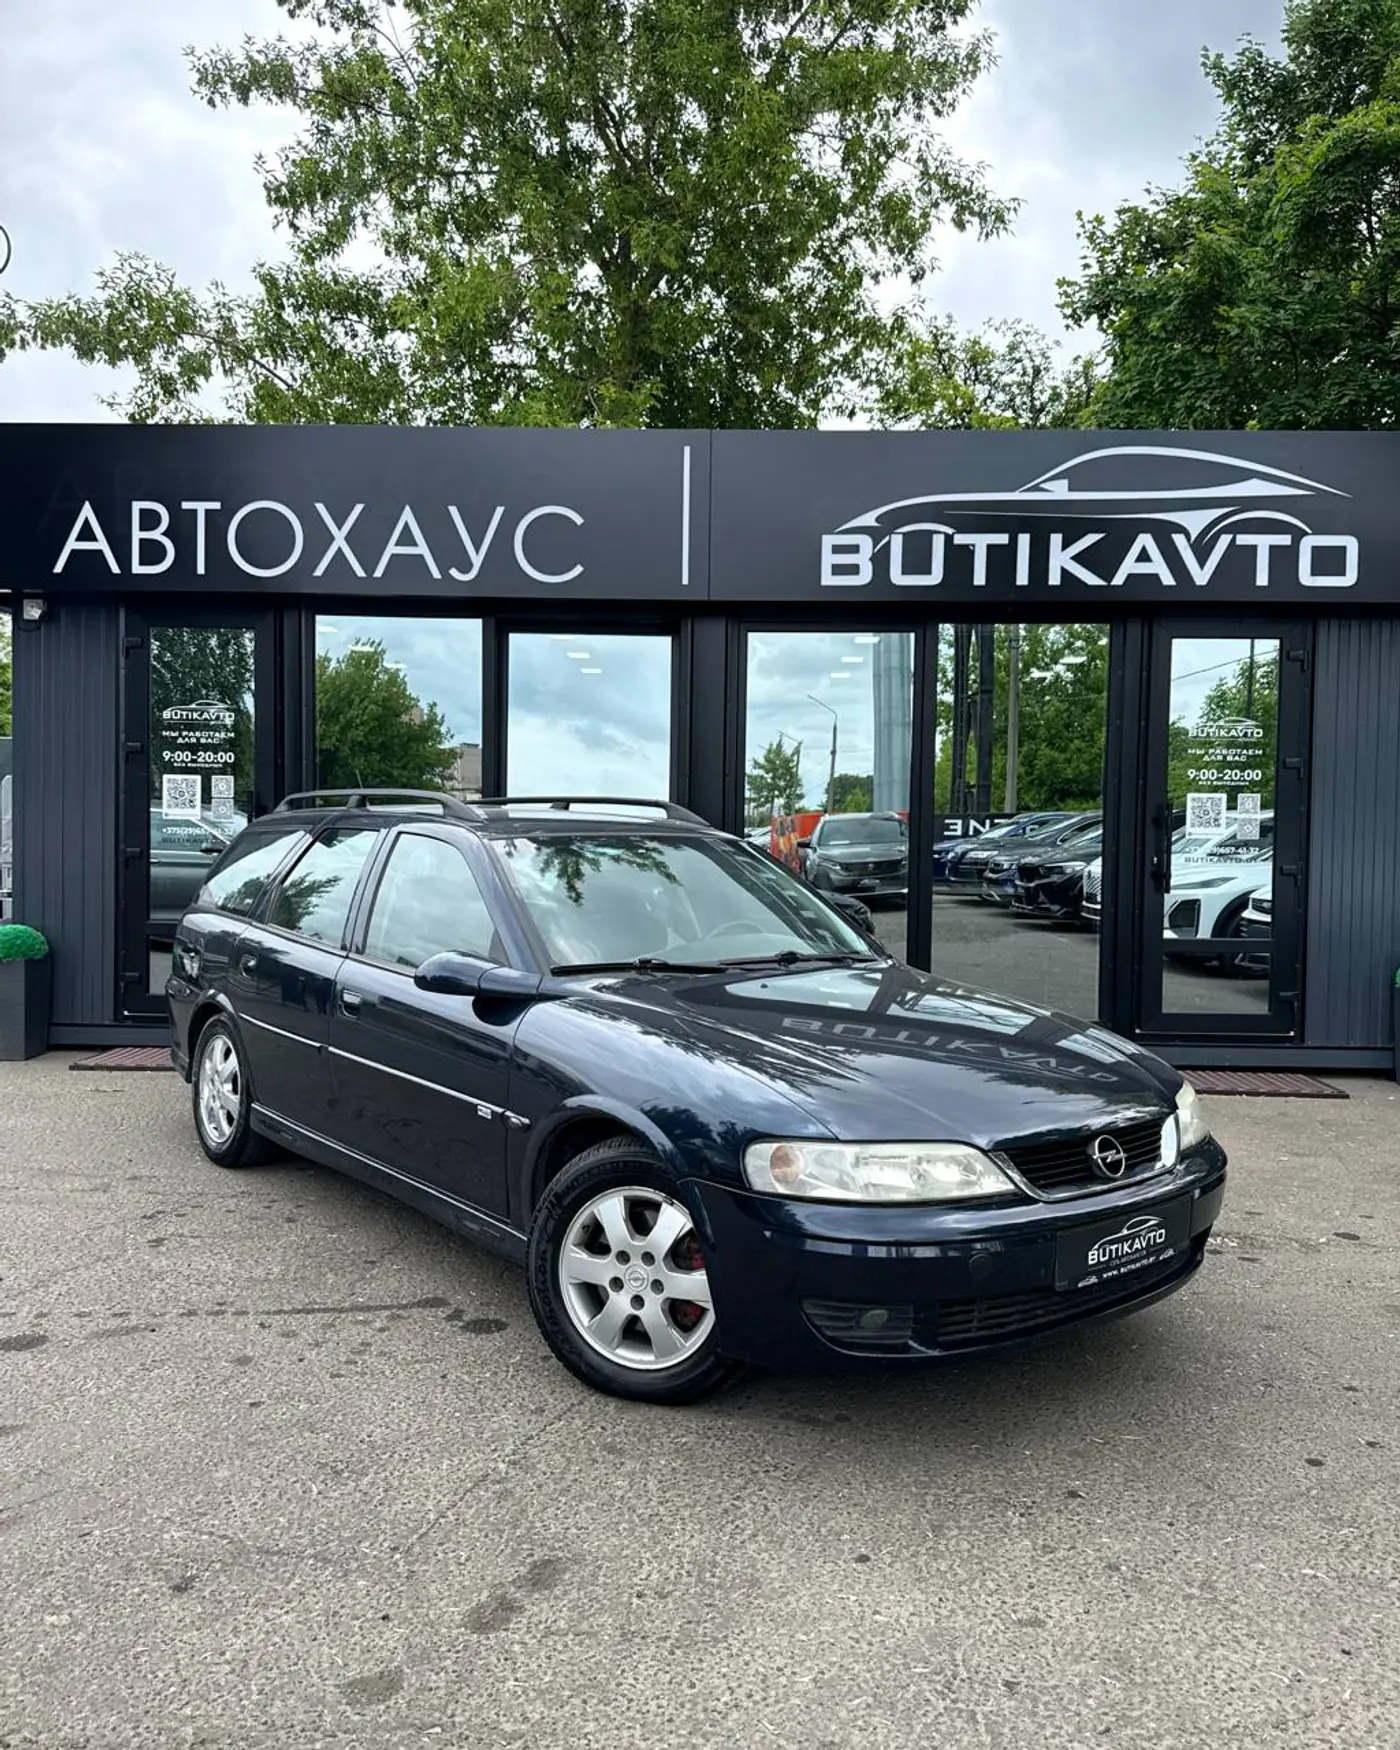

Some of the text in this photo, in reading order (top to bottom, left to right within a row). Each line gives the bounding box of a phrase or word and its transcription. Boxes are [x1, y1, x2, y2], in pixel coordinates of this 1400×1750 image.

[52, 500, 585, 584] АВТОХАУС
[820, 531, 1359, 587] BUTIKAVTO
[162, 709, 235, 721] BUTIKAVTO
[181, 730, 235, 738] РАБОТАЕМ
[1188, 727, 1264, 738] BUTIKAVTO
[162, 750, 235, 763] 9:00-20:00
[1208, 748, 1263, 756] РАБОТАЕМ
[1187, 769, 1262, 781] 9:00-20:00
[1088, 1228, 1166, 1265] BUTIKAVTO
